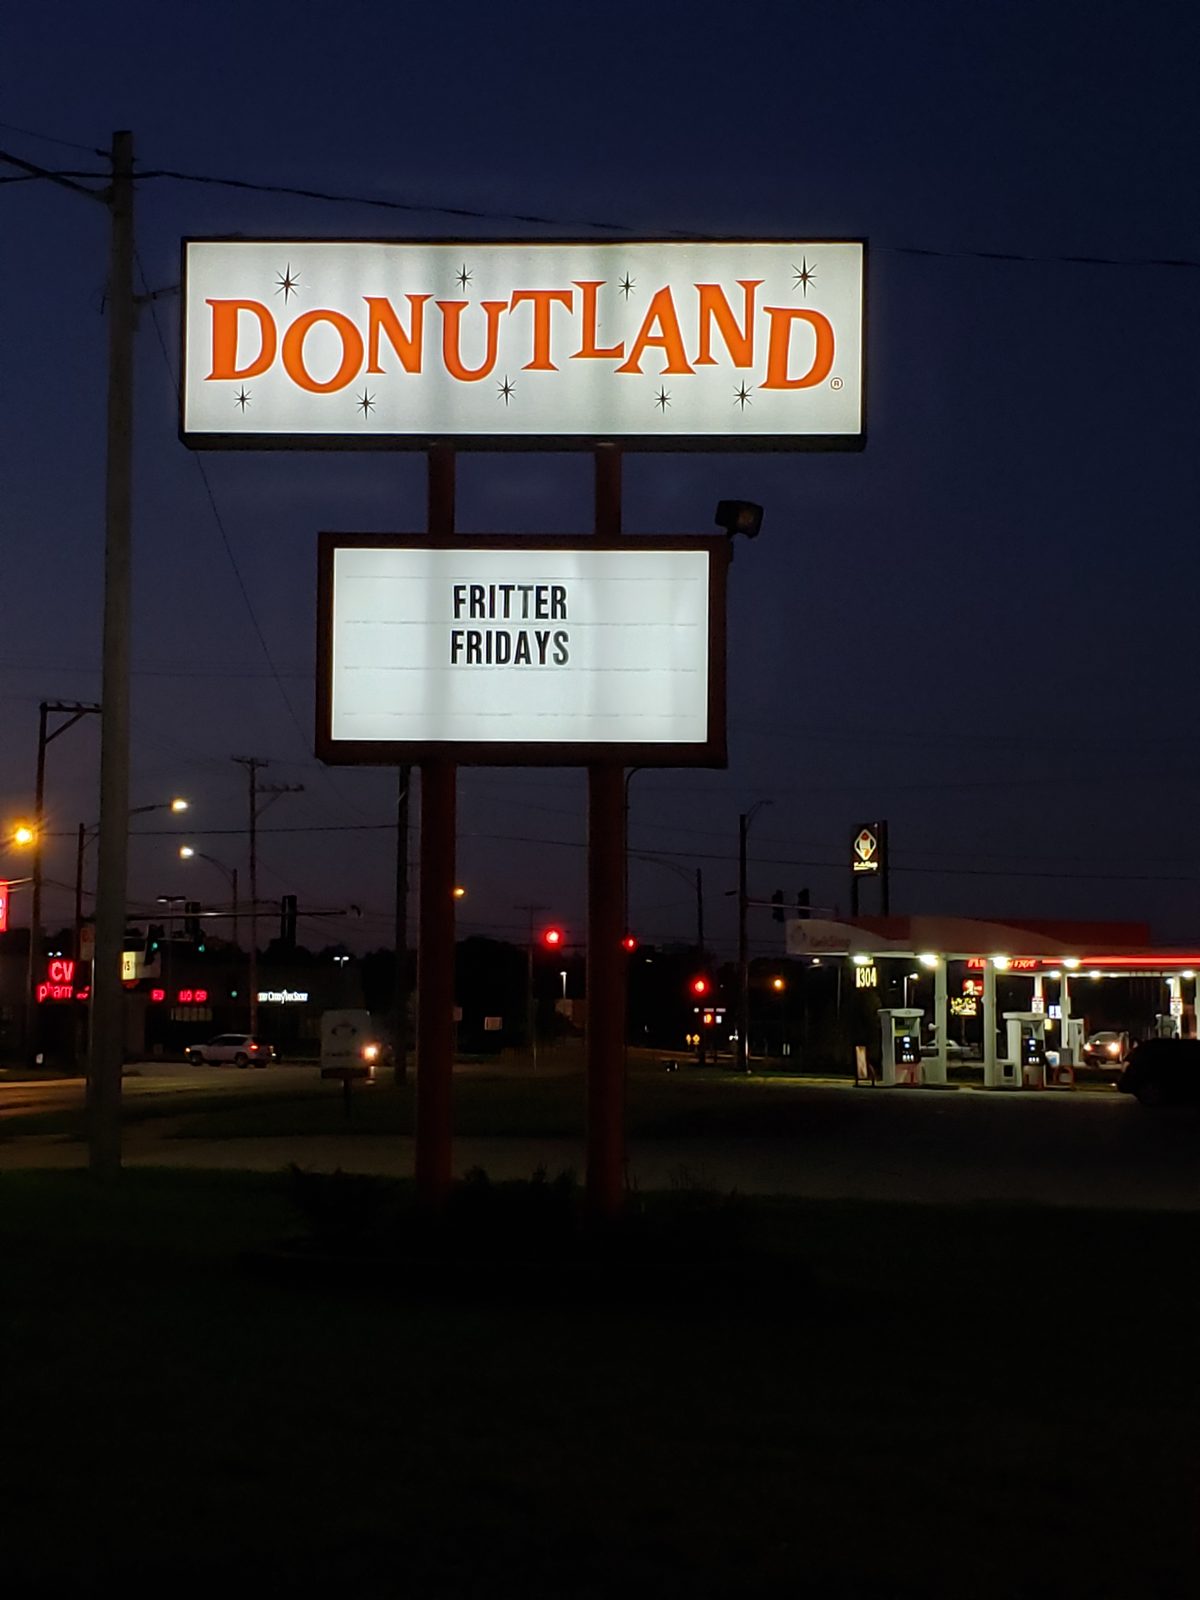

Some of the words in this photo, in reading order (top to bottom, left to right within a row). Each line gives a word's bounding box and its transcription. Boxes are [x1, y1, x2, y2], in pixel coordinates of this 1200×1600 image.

[204, 280, 835, 394] DONUTLAND
[454, 585, 566, 619] FRITTER
[451, 631, 568, 665] FRIDAYS
[50, 960, 75, 982] CV
